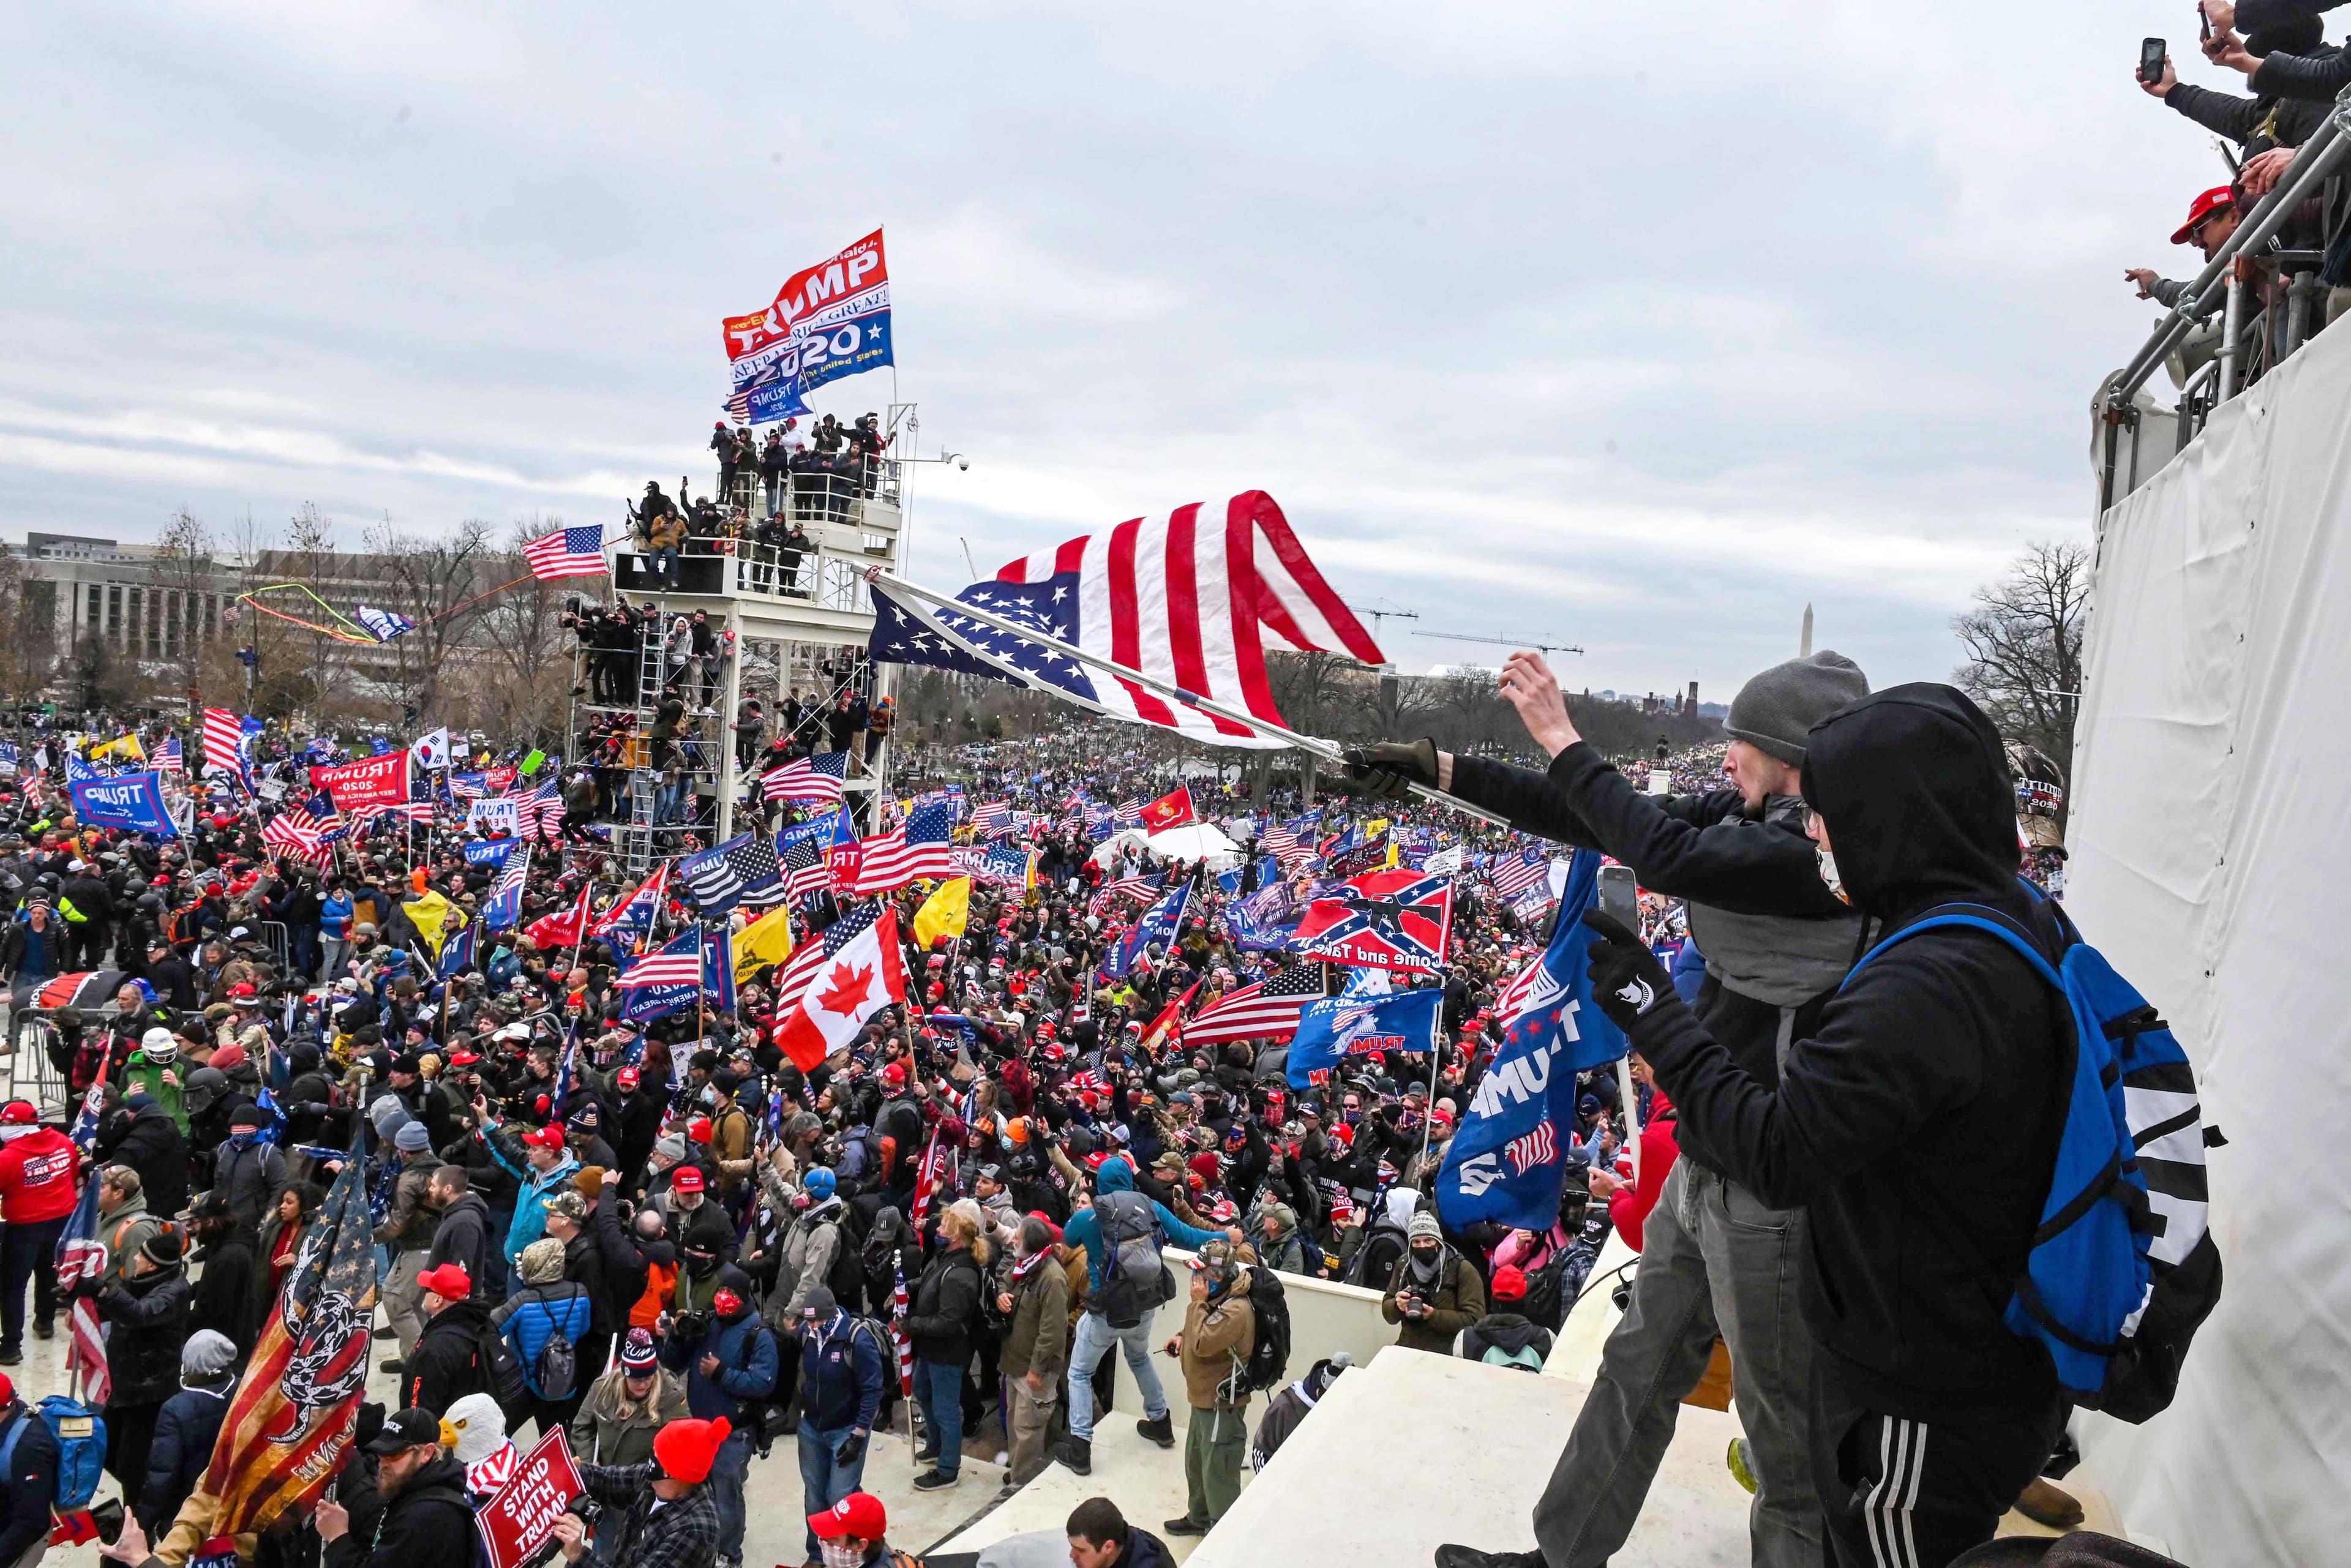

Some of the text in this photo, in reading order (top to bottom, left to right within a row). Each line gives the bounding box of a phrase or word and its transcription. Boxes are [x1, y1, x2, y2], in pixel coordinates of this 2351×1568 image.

[730, 250, 879, 351] TRUMP
[828, 290, 887, 320] GREAT!
[754, 324, 861, 387] 2020
[2030, 798, 2058, 811] 2020
[625, 1340, 654, 1357] RUM
[503, 1457, 549, 1518] STAND
[515, 1479, 555, 1529] WITH
[515, 1491, 567, 1553] TRUMP
